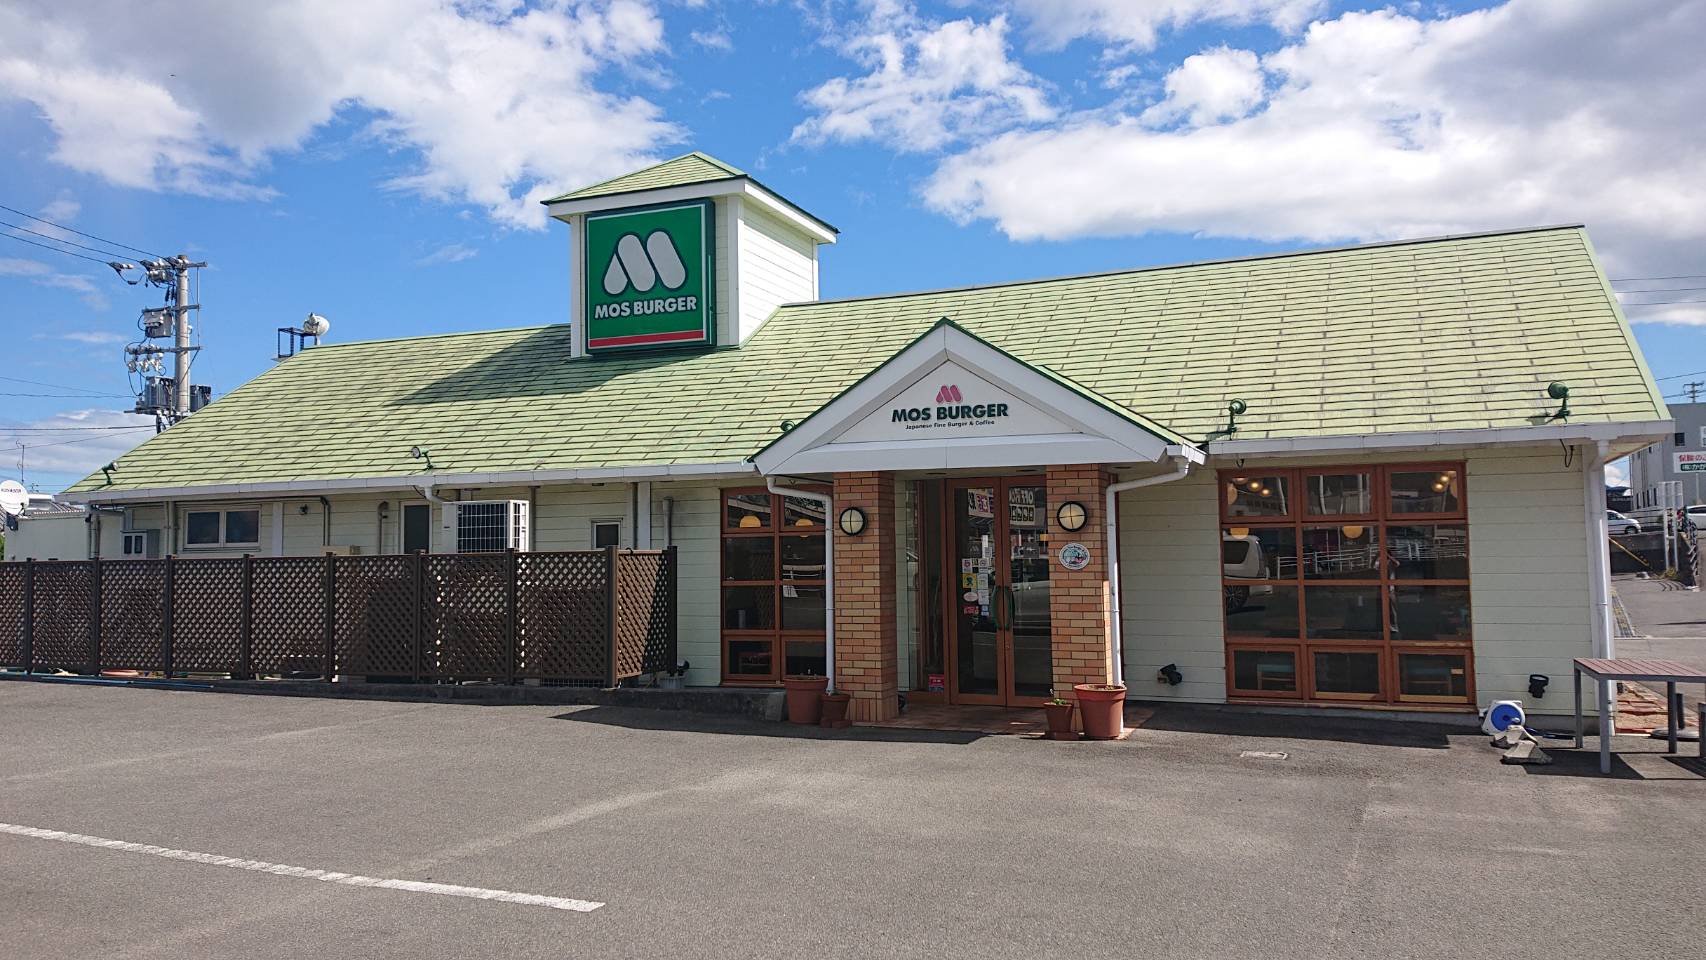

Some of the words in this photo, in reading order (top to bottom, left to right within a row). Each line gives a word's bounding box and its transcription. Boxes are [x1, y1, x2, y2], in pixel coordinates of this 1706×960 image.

[594, 302, 631, 319] MOS
[633, 296, 697, 315] BURGER
[892, 407, 931, 422] MOS
[936, 403, 1008, 420] BURGER
